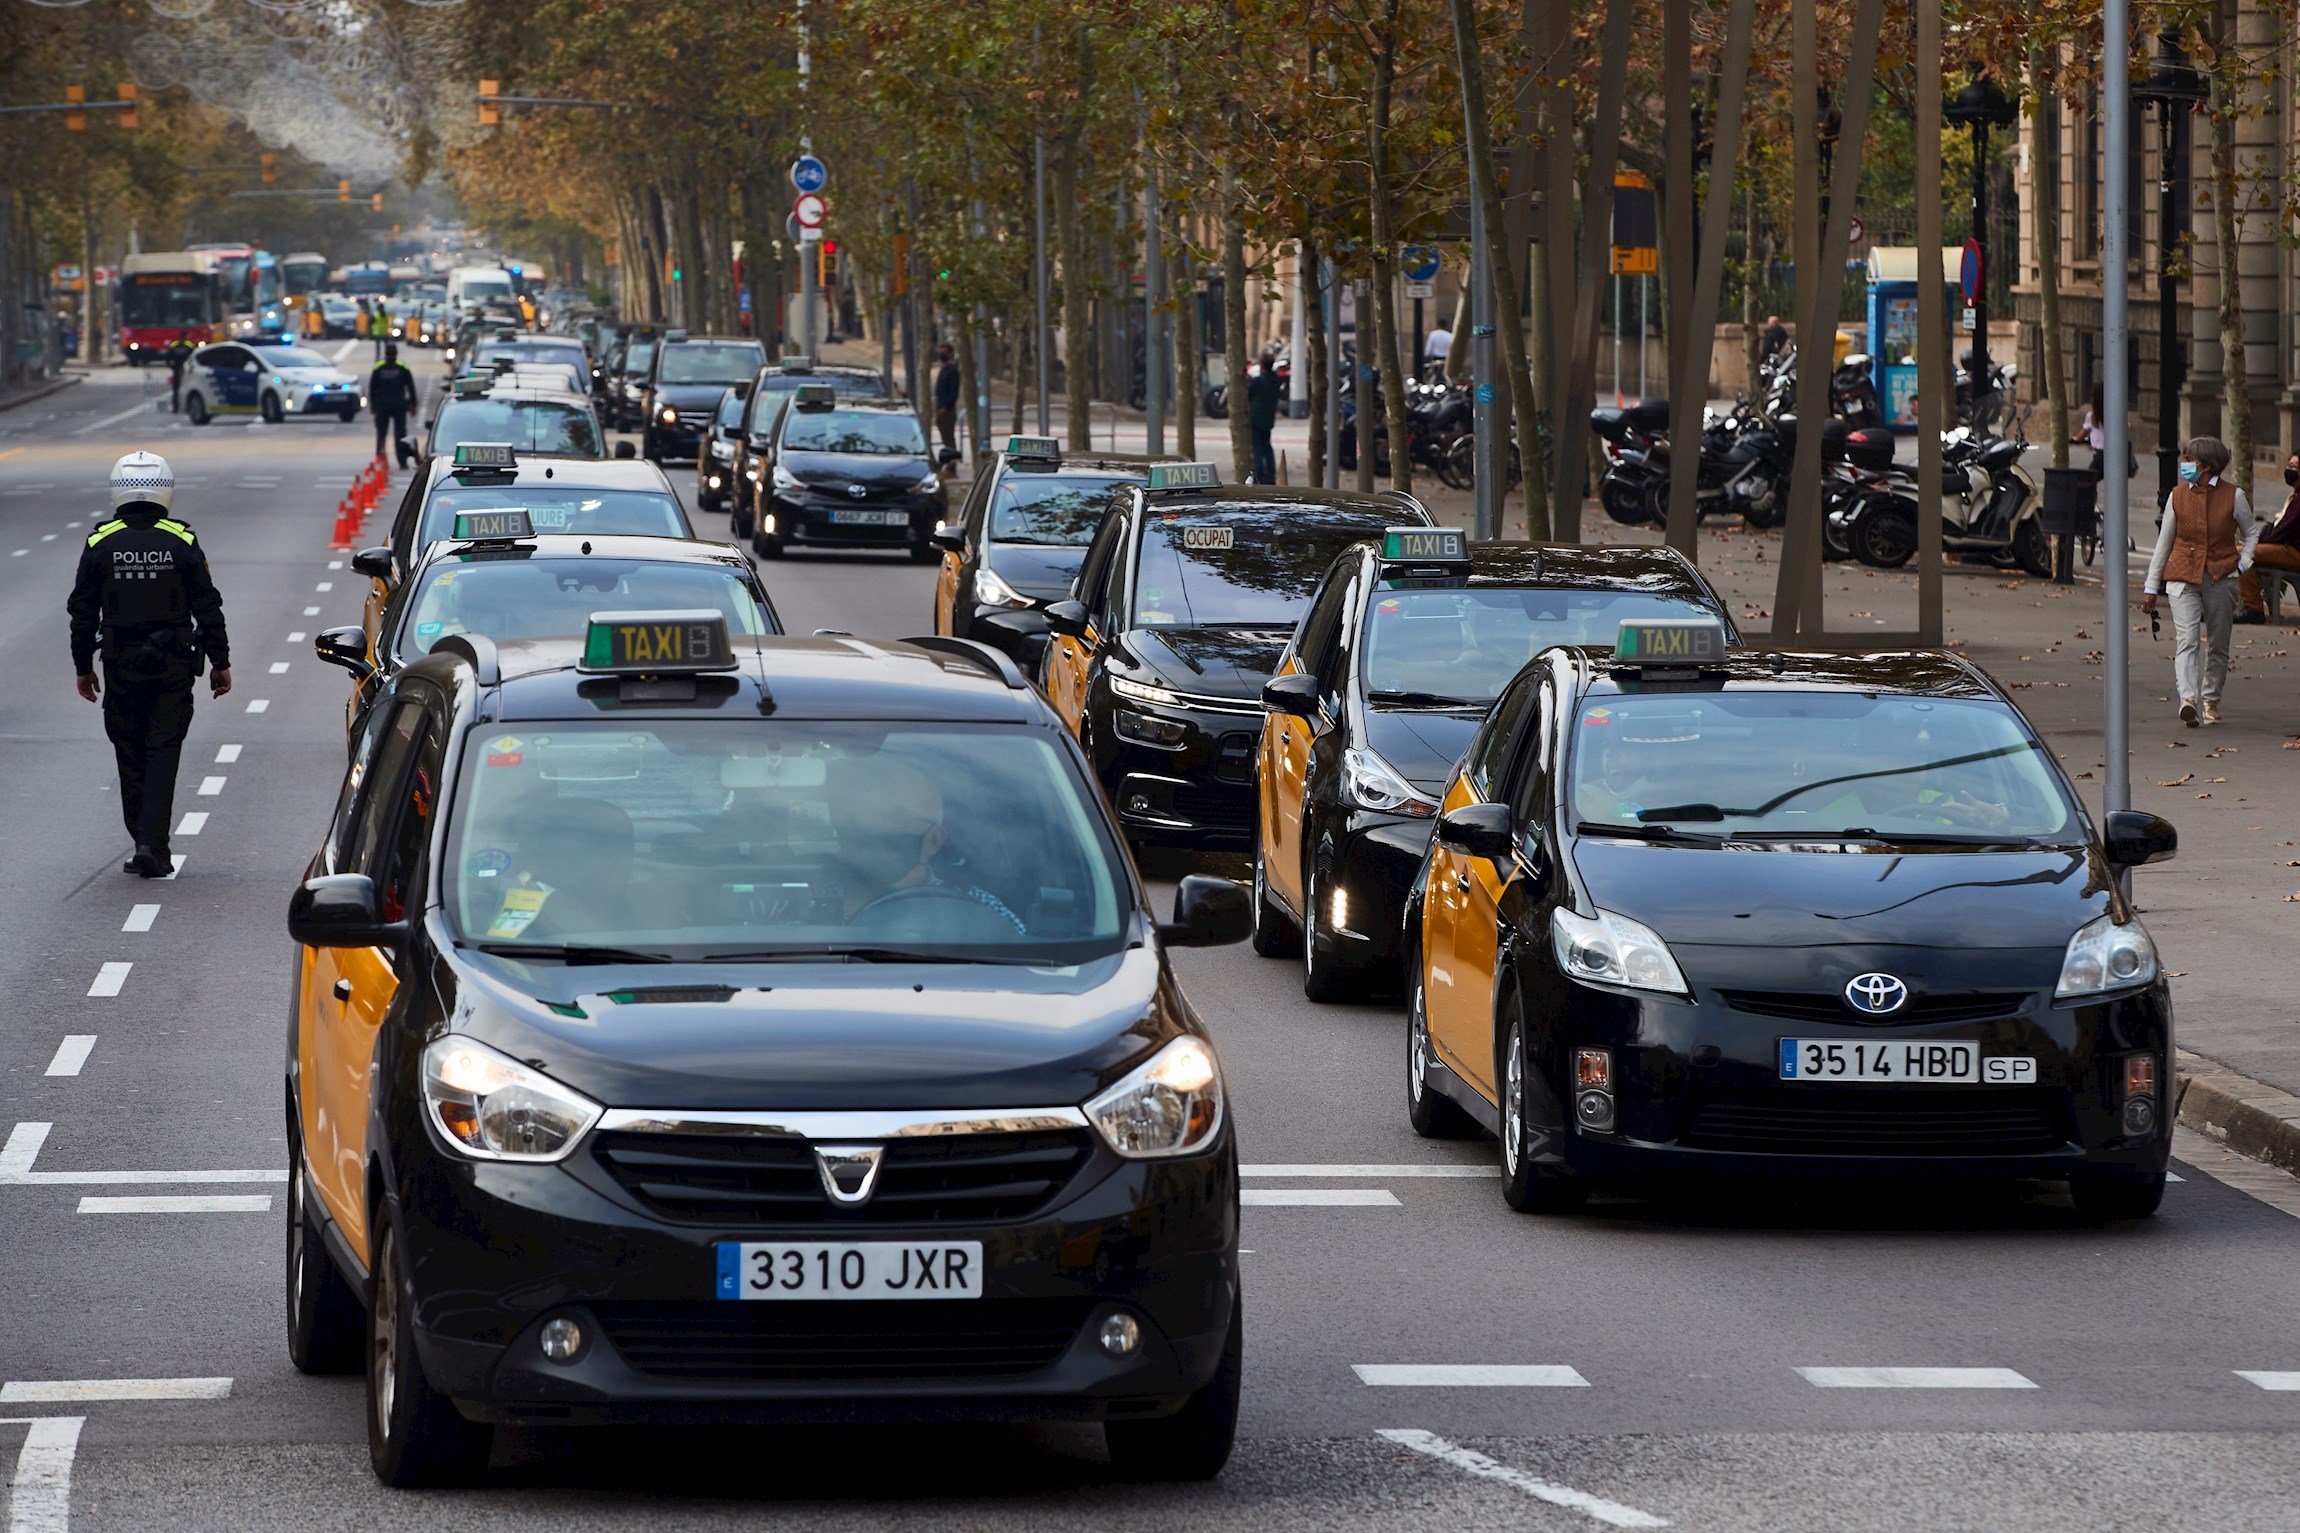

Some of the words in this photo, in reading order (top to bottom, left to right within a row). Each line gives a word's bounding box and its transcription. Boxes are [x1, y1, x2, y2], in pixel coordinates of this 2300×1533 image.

[468, 448, 494, 462] TAXI
[1021, 440, 1042, 452] TAXI
[1165, 467, 1196, 485] TAXI
[472, 515, 505, 534] TAXI
[1186, 528, 1231, 547] OCUPAT
[1403, 534, 1440, 555] TAXI
[113, 551, 174, 563] POLICIA
[620, 626, 683, 661] TAXI
[1642, 629, 1689, 655] TAXI
[1804, 1044, 1891, 1076] 3514
[1905, 1045, 1970, 1077] HBD
[1988, 1060, 2031, 1080] SP
[723, 1277, 733, 1289] E
[750, 1250, 865, 1290] 3310
[884, 1249, 969, 1290] JXR
